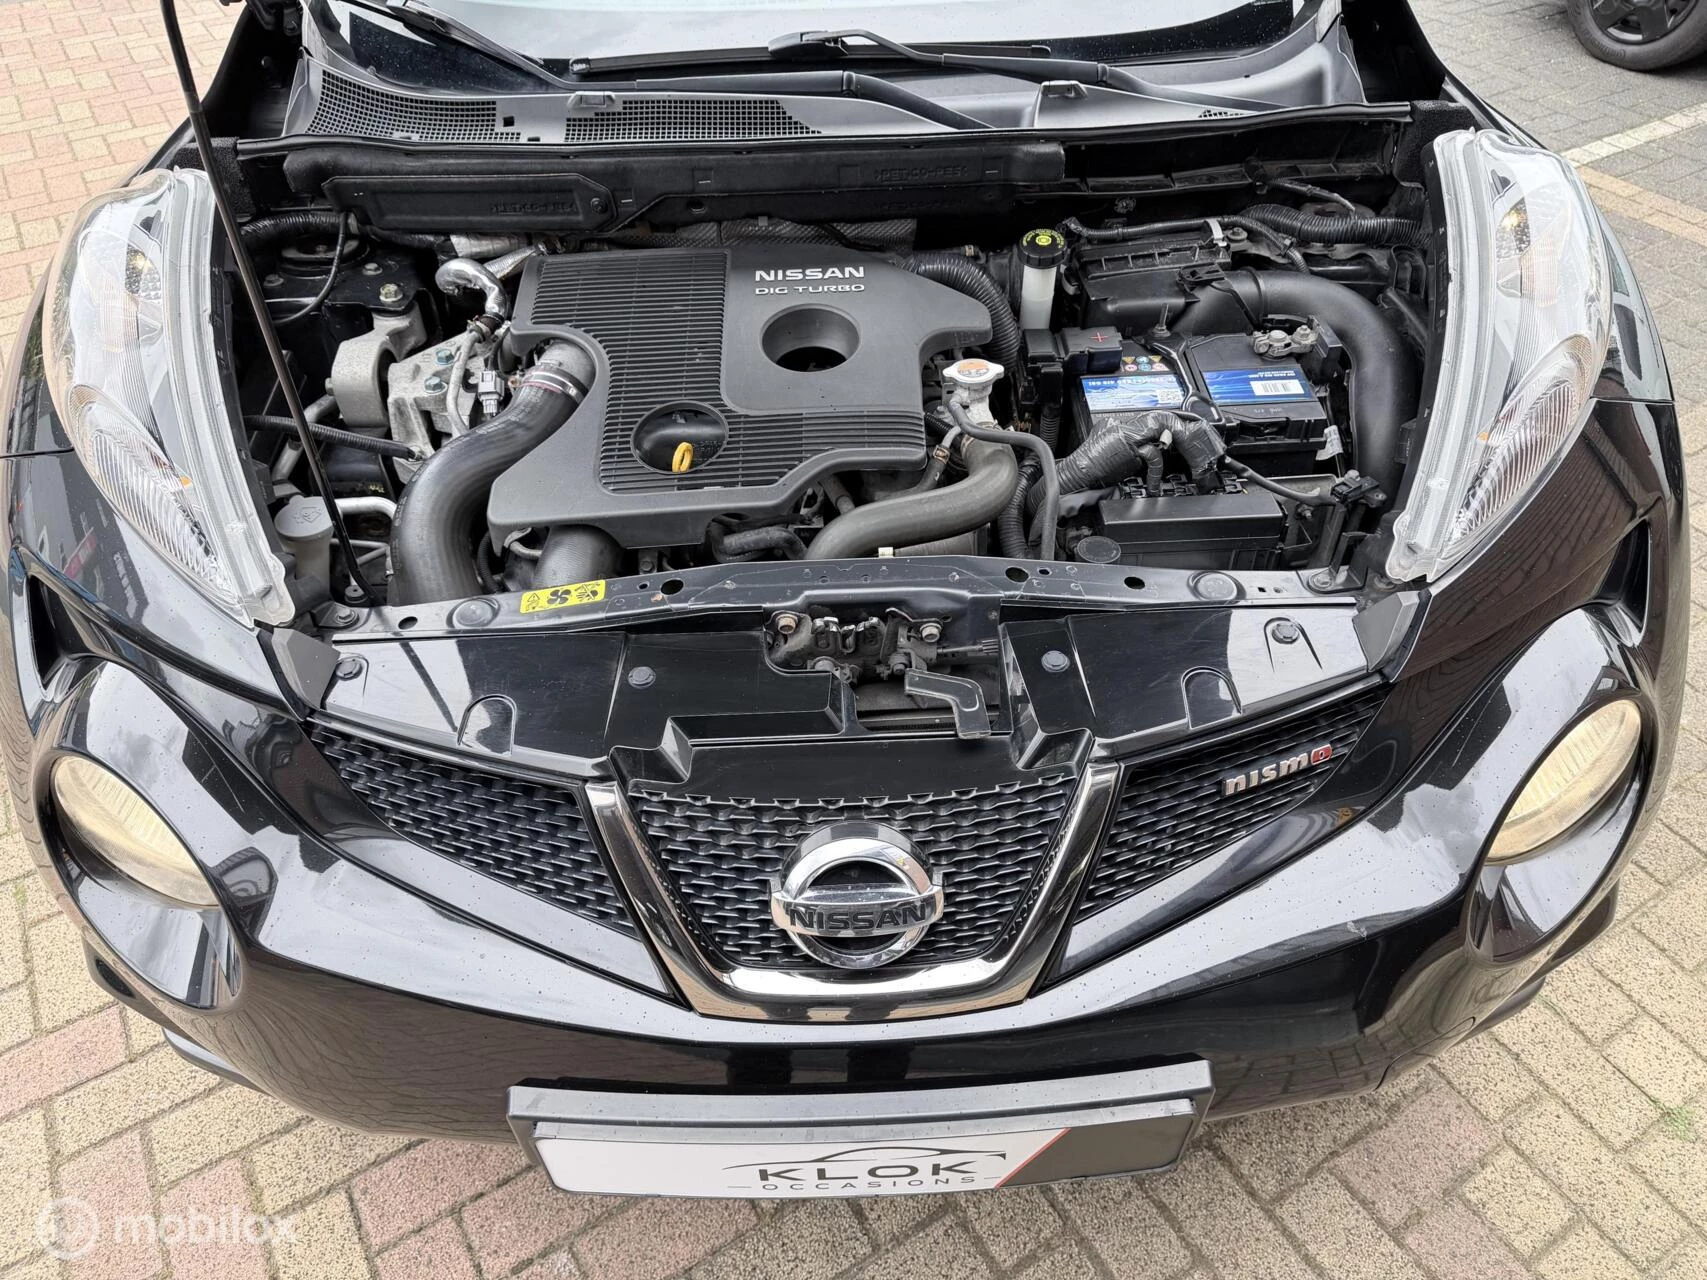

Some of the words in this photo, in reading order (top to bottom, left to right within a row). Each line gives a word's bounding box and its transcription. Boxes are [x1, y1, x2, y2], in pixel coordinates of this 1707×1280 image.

[755, 266, 865, 281] NISSAN
[755, 286, 788, 295] DIG
[793, 284, 865, 293] TURBO
[1225, 744, 1332, 796] nismo
[789, 903, 926, 929] NISSAN
[758, 1160, 978, 1182] KLOK
[761, 1176, 976, 1191] OCCASIONS
